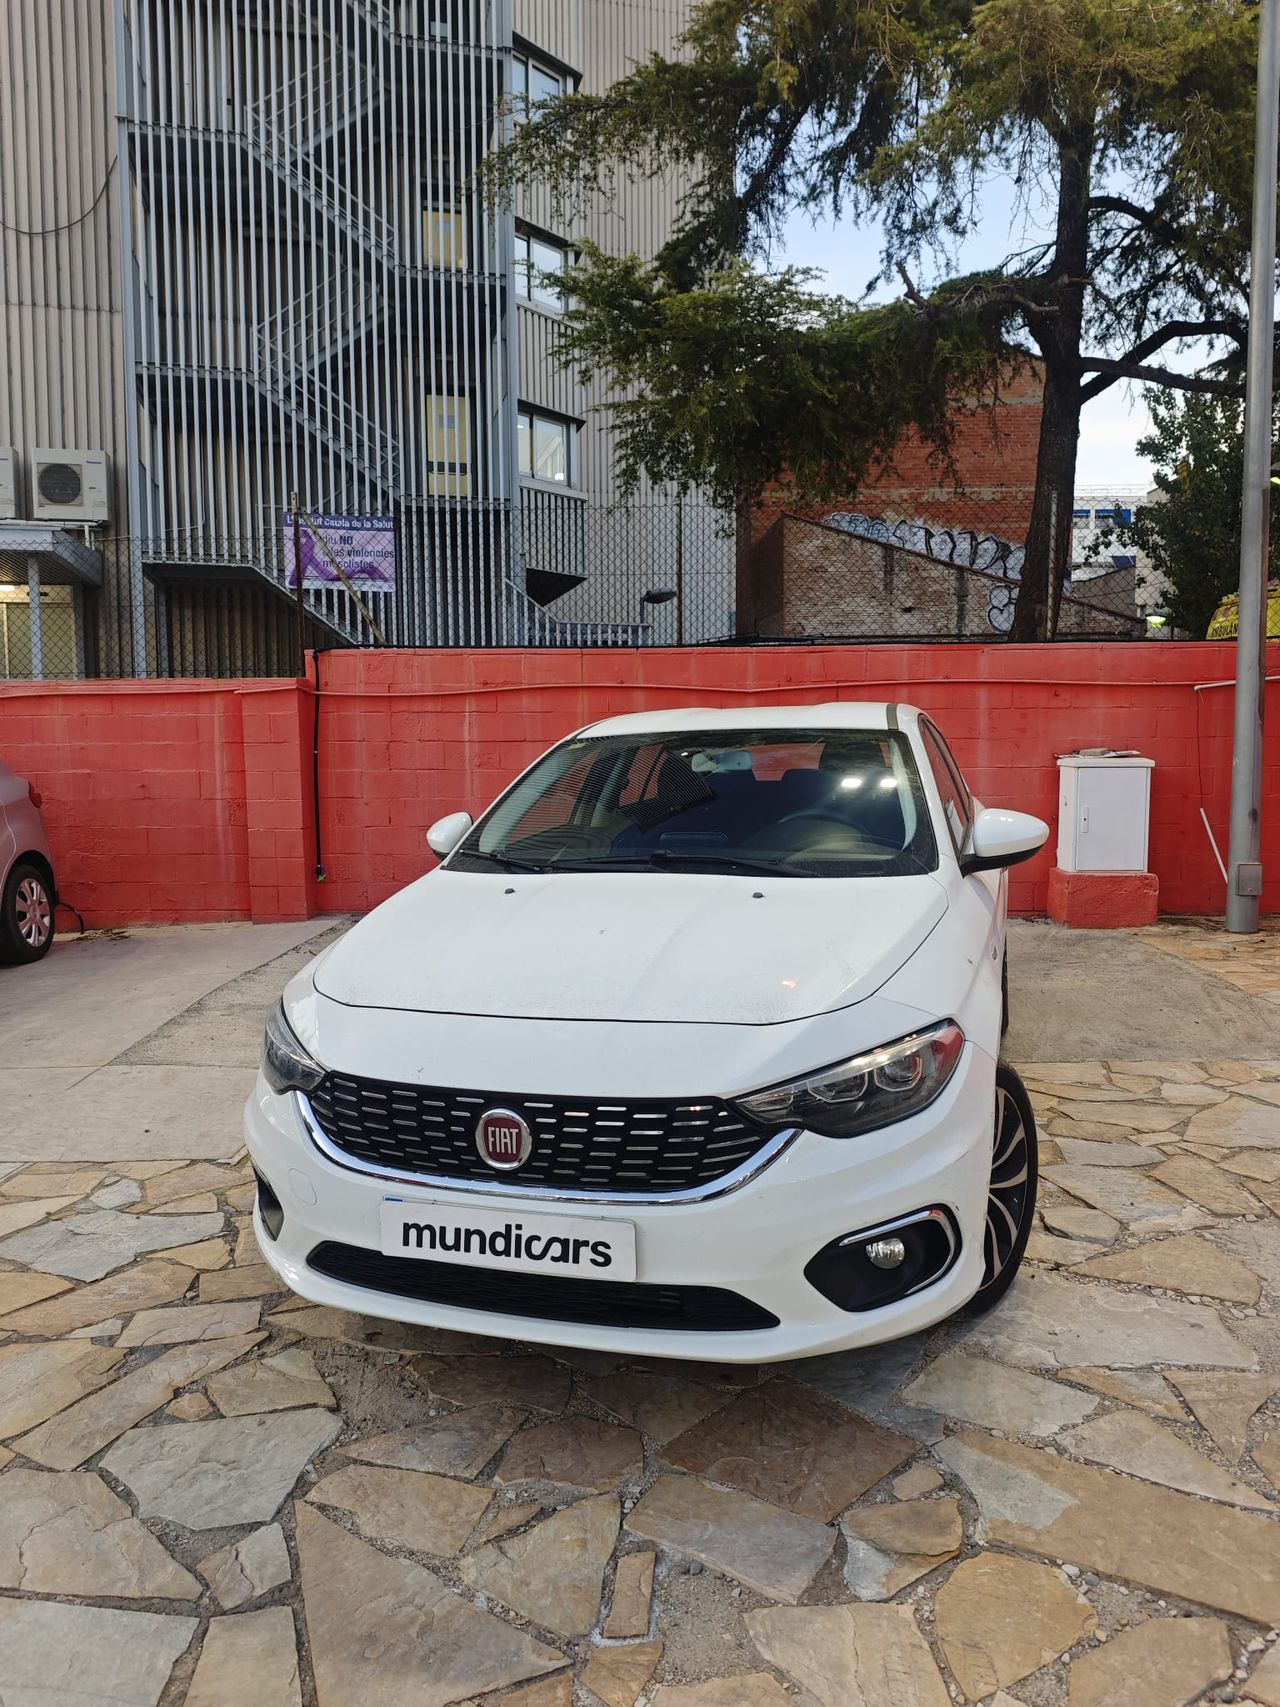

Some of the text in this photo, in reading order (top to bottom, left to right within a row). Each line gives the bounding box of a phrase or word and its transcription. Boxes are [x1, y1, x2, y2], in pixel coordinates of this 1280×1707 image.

[352, 519, 362, 528] de
[363, 519, 371, 528] la
[373, 520, 394, 529] Salut
[339, 535, 353, 545] NO
[487, 1126, 519, 1154] FIAT
[402, 1221, 612, 1268] mundicars
